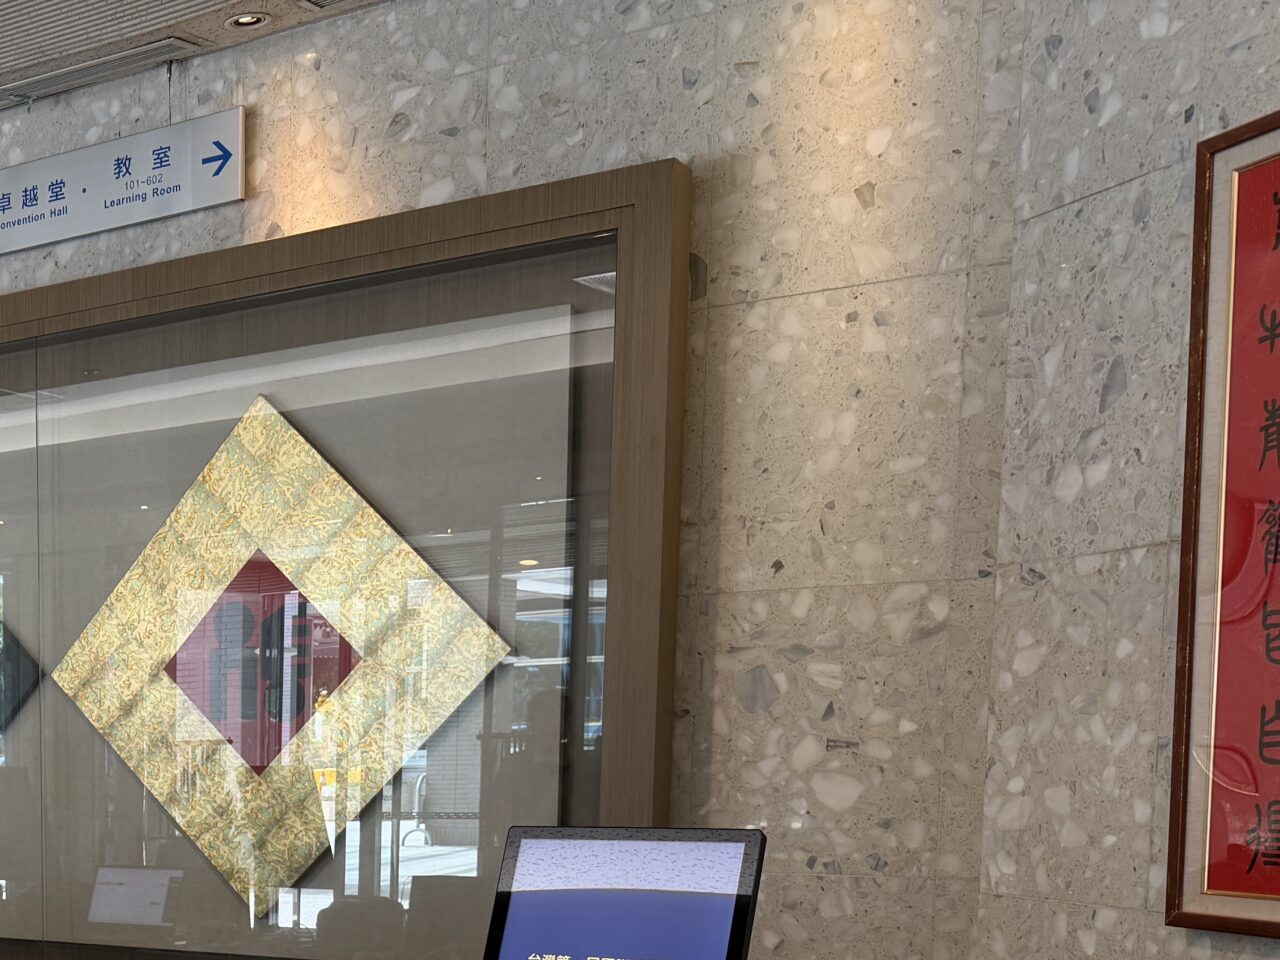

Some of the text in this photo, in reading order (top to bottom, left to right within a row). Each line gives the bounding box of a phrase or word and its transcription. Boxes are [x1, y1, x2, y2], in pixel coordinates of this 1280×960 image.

[113, 145, 171, 179] 教室
[125, 173, 163, 190] 101~602
[104, 184, 181, 209] Learning Room
[49, 205, 68, 218] Hall
